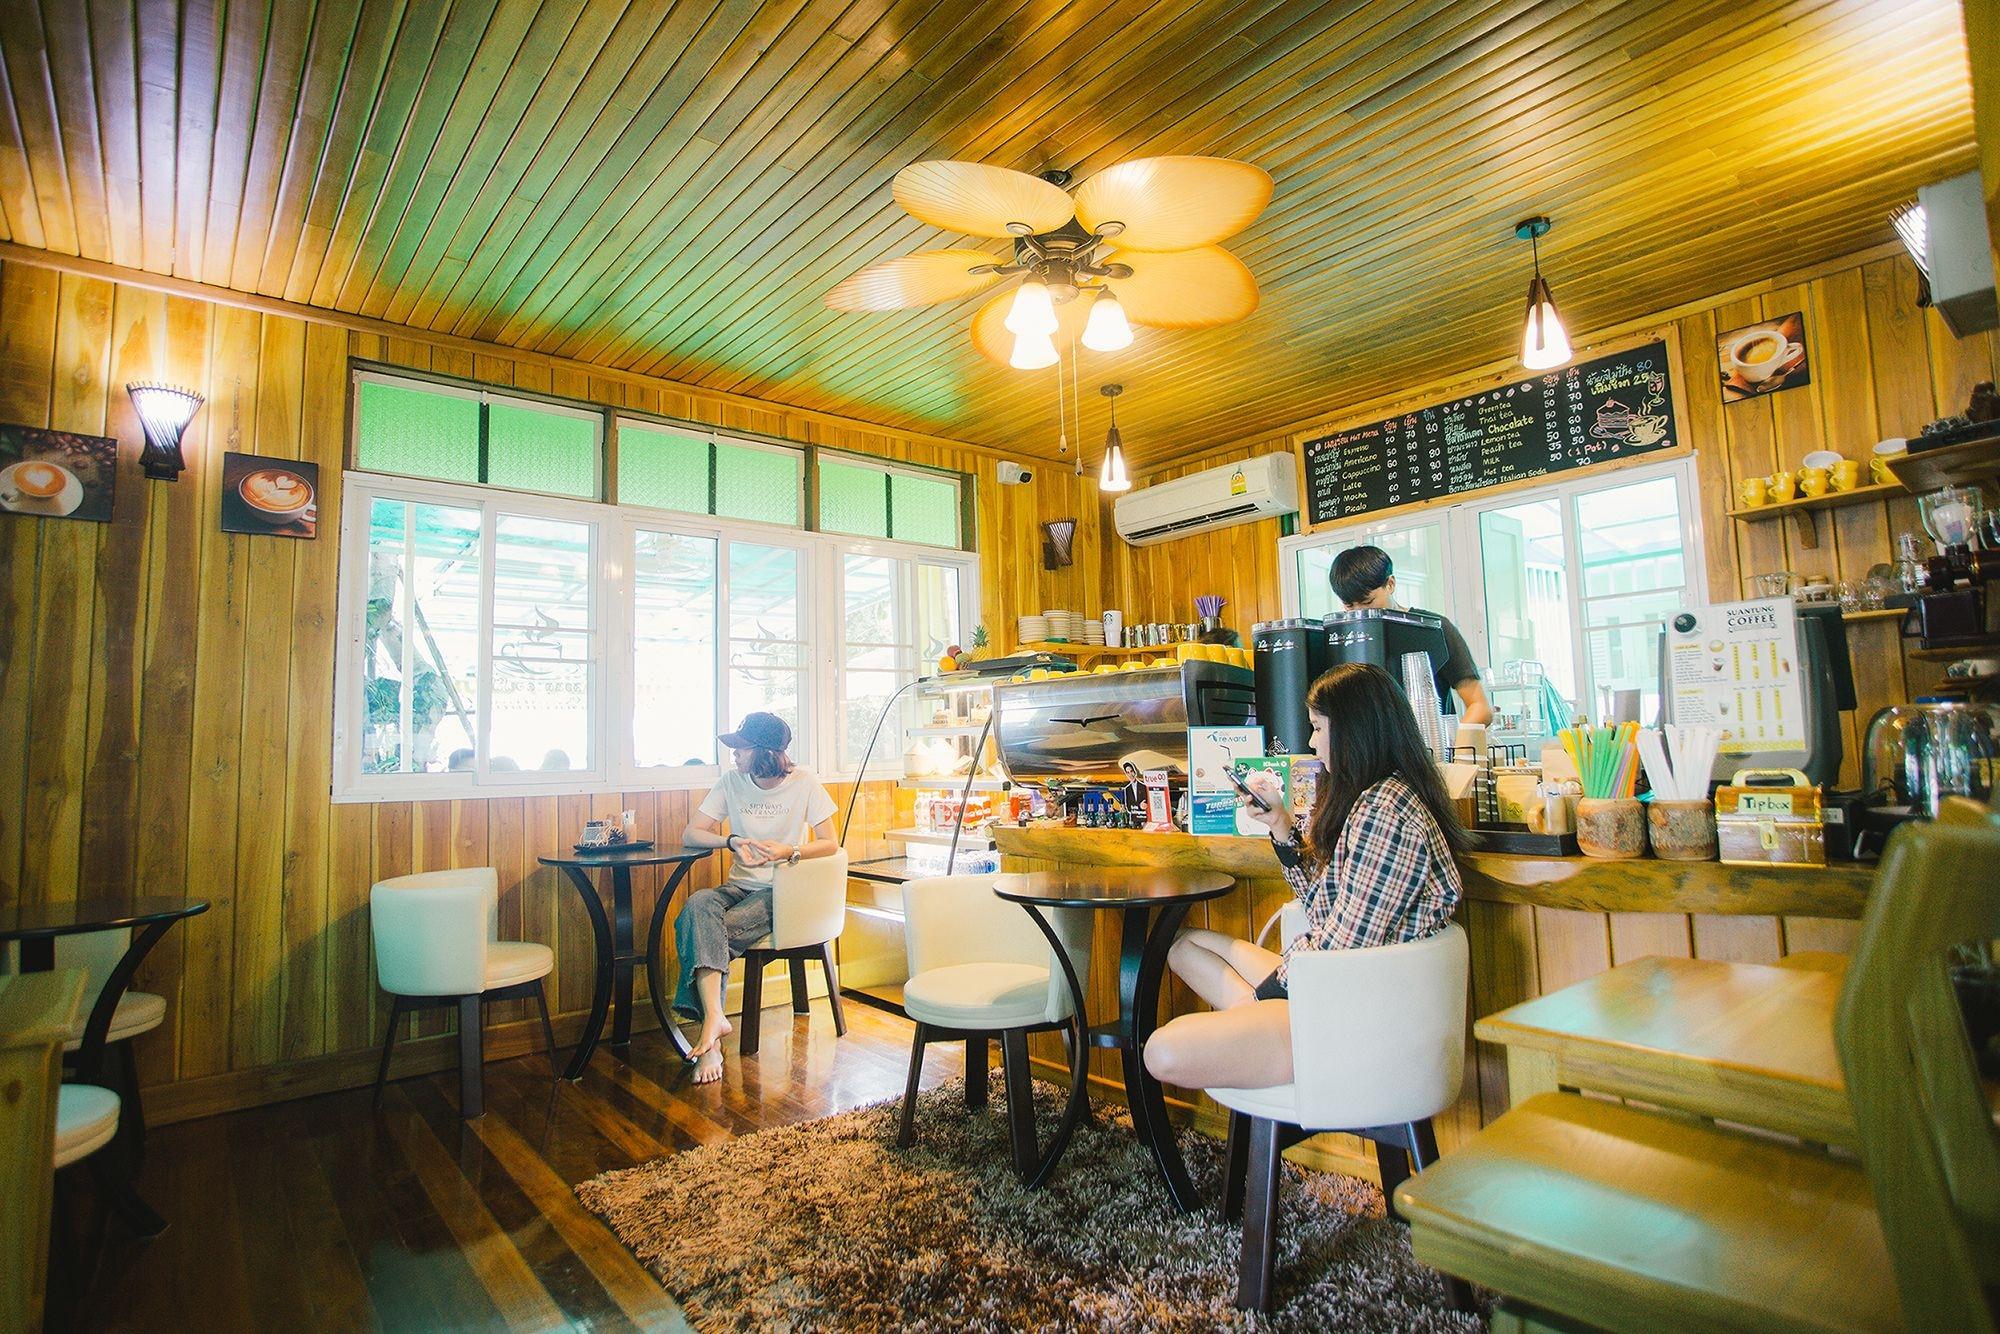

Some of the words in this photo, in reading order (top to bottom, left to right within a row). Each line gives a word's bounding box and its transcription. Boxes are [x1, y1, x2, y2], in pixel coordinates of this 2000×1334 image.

[1637, 360, 1652, 371] 80
[1633, 372, 1650, 385] 25
[1544, 388, 1554, 398] 50
[1566, 380, 1580, 392] 70
[1478, 414, 1496, 426] Thai
[1500, 410, 1514, 420] tea
[1544, 400, 1555, 408] 50
[1568, 392, 1582, 402] 70
[1488, 416, 1534, 434] Chocolate
[1545, 410, 1556, 420] 50
[1570, 402, 1584, 414] 70
[1546, 422, 1557, 430] 50
[1568, 415, 1581, 424] 60
[1344, 444, 1370, 456] Espresso
[1385, 436, 1395, 444] 50
[1405, 430, 1416, 440] 70
[1426, 422, 1438, 434] 80
[1481, 444, 1504, 456] Peach
[1508, 441, 1523, 450] tea
[1546, 432, 1560, 442] 50
[1570, 426, 1581, 434] 60
[1548, 440, 1562, 451] 35
[1572, 436, 1585, 446] 50
[1344, 454, 1378, 467] Americano
[1386, 448, 1396, 456] 50
[1406, 442, 1418, 451] 60
[1342, 464, 1381, 480] Cappuccino
[1387, 460, 1398, 468] 60
[1408, 454, 1418, 463] 70
[1428, 448, 1440, 458] 80
[1388, 472, 1398, 480] 60
[1408, 466, 1420, 474] 70
[1430, 460, 1441, 470] 80
[1484, 467, 1496, 476] Hot
[1502, 464, 1515, 472] tea
[1550, 452, 1562, 462] 50
[1500, 471, 1526, 483] Italian
[1528, 467, 1548, 477] Soda
[1344, 491, 1368, 502] Mocha
[1388, 484, 1399, 492] 60
[1410, 478, 1420, 487] 70
[1432, 472, 1443, 482] 80
[1390, 494, 1400, 504] 60
[1727, 605, 1774, 616] SUANTUNG
[1728, 614, 1775, 627] COFFEE
[1219, 735, 1247, 743] reward
